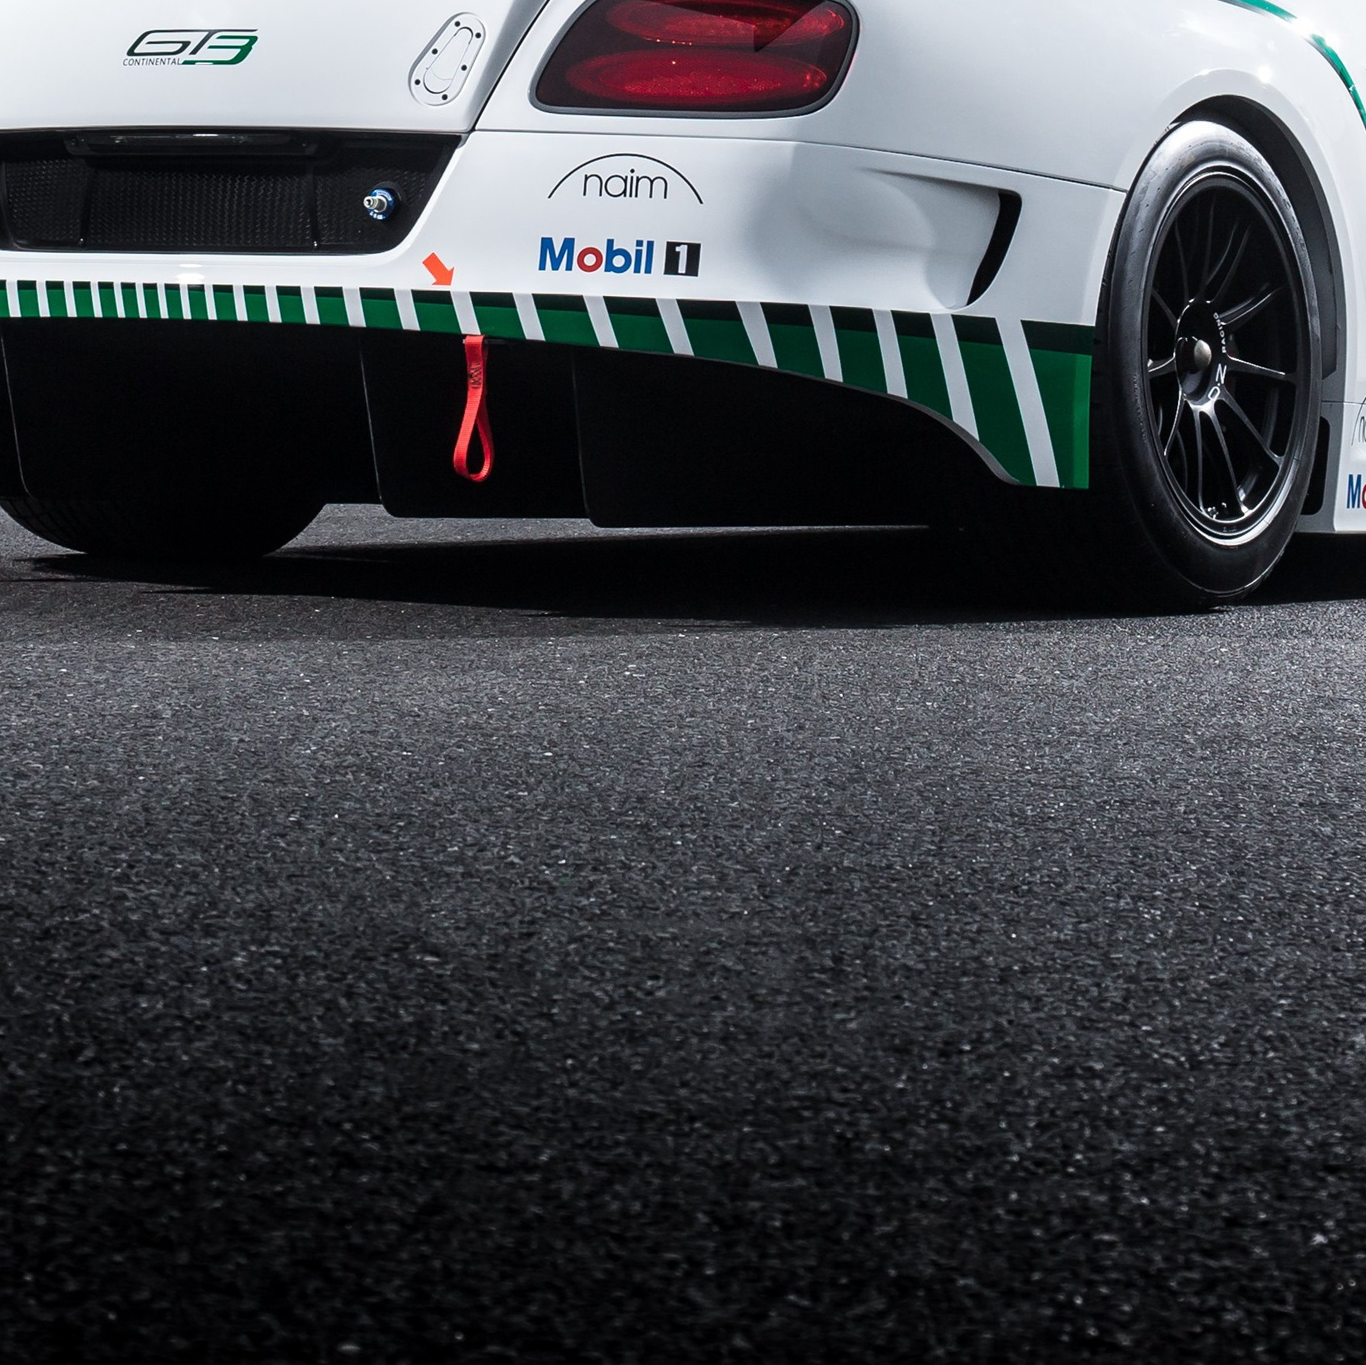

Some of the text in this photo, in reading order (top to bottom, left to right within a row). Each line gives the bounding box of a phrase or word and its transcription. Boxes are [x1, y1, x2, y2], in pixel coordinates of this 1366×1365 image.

[122, 58, 182, 66] CONTINENTAL
[126, 29, 258, 65] GT3
[583, 168, 668, 199] naim
[538, 237, 655, 274] Mobil
[1213, 312, 1228, 353] RACING
